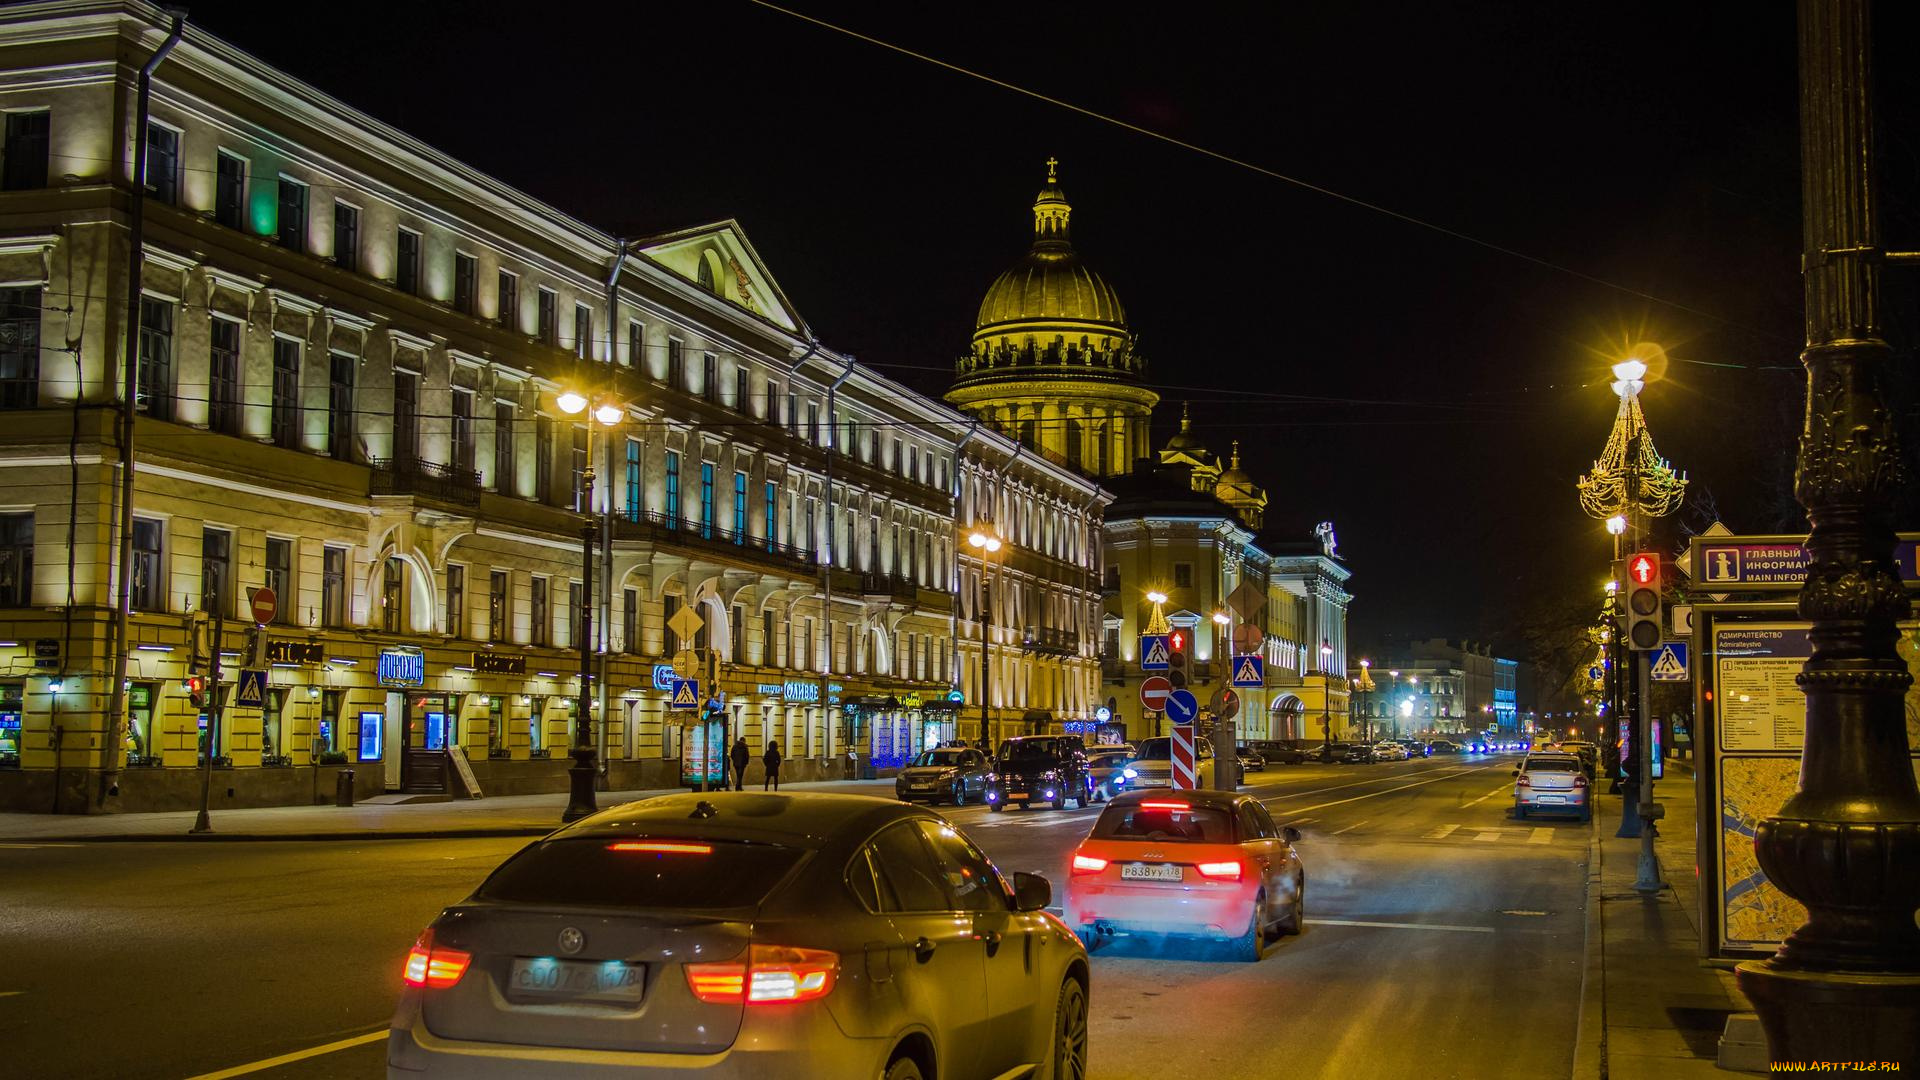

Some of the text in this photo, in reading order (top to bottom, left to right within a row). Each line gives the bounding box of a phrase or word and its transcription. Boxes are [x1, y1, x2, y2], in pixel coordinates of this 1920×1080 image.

[1745, 548, 1801, 558] ГЛАВНЫЙ
[1746, 573, 1772, 582] MAIN
[1719, 631, 1783, 639] АДМИРАЛТЕЙСТВО
